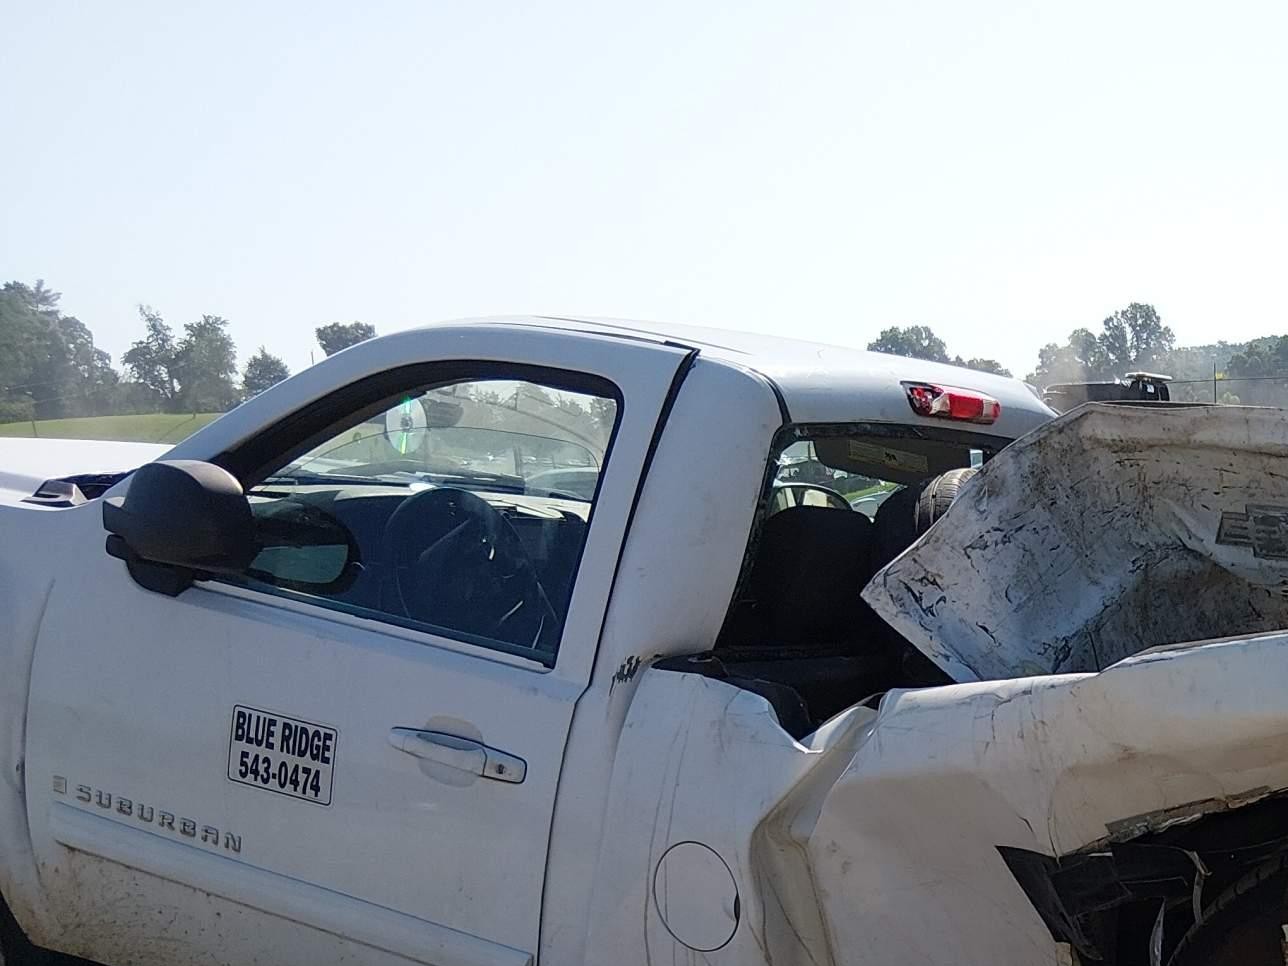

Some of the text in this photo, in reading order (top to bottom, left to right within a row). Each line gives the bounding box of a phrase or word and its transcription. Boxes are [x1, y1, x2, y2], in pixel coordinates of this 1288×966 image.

[235, 710, 333, 765] BLUE RIDGE
[239, 750, 321, 798] 543-0474
[76, 784, 242, 853] SUBURBAN
